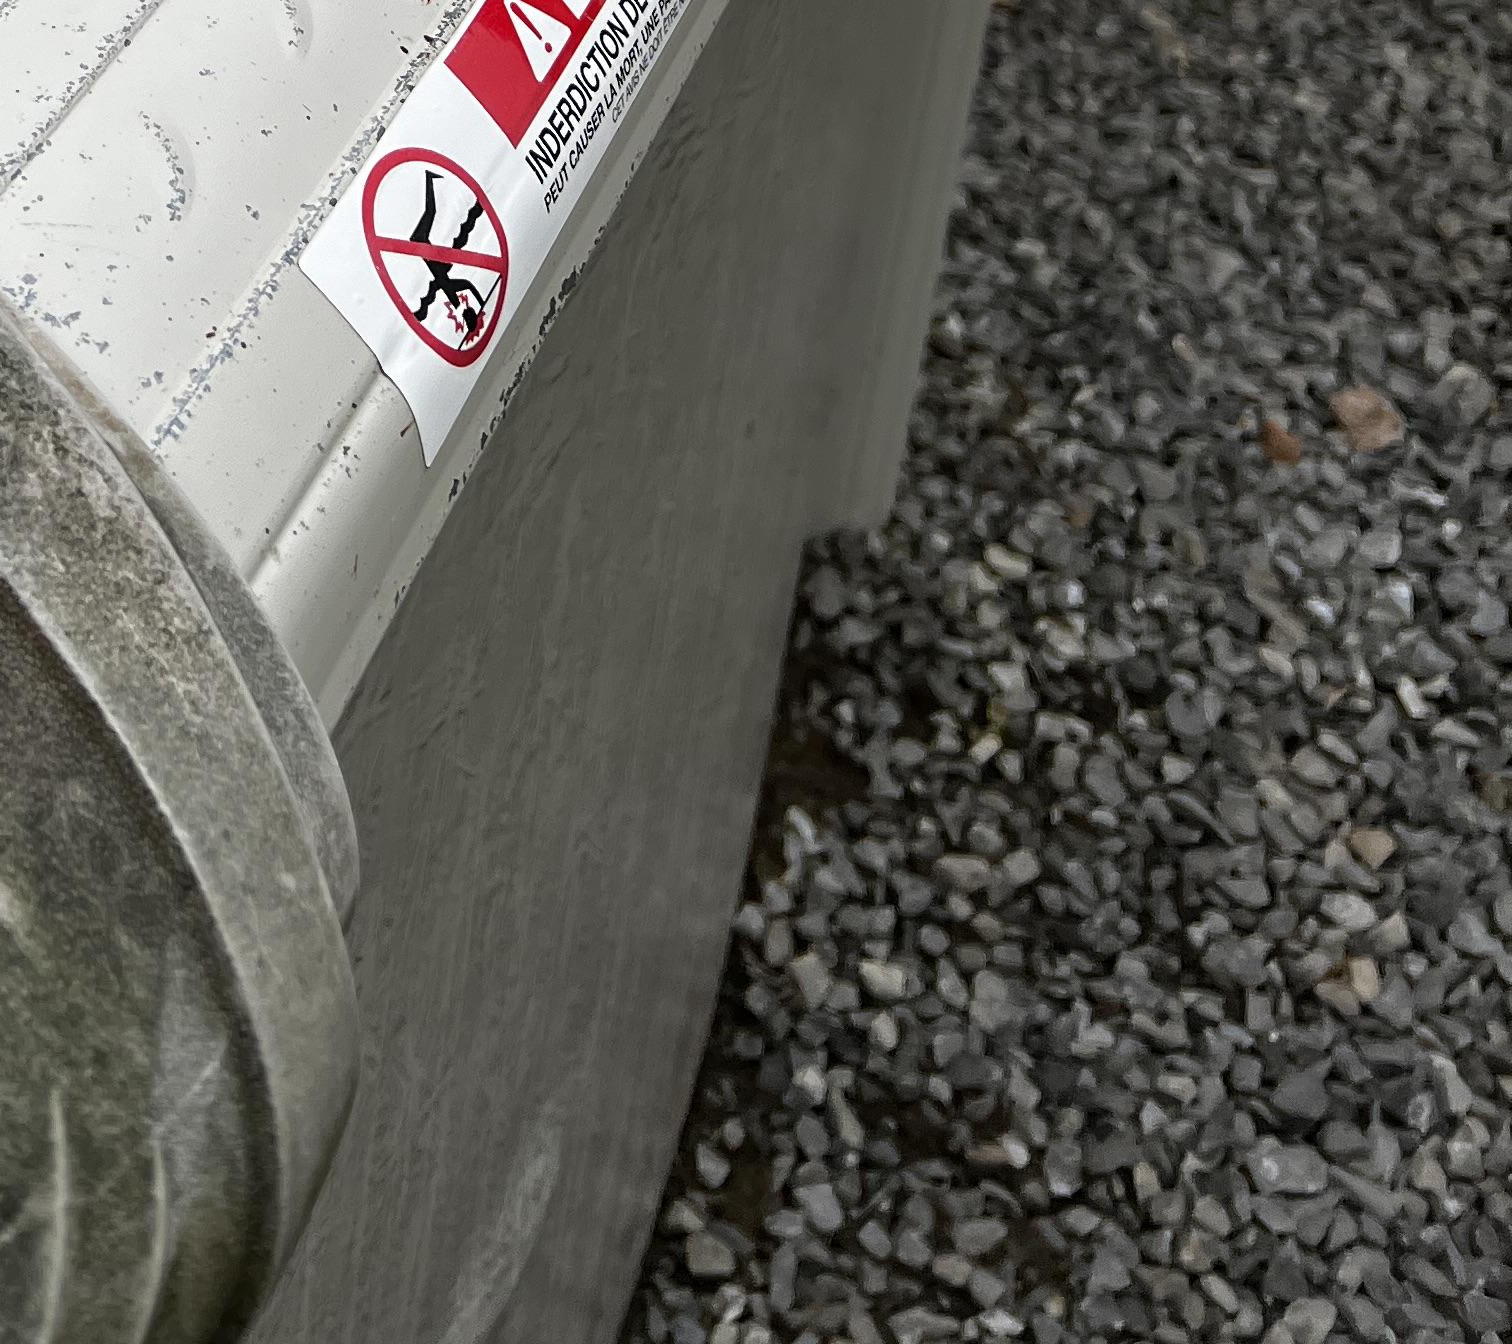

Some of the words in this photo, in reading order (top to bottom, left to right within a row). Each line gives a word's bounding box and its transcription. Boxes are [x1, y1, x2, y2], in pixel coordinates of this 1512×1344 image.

[525, 11, 629, 184] INDERDICTION
[544, 162, 568, 214] PEUT
[569, 102, 605, 170] CAUSER
[604, 83, 617, 109] LA
[641, 7, 660, 44] UNE
